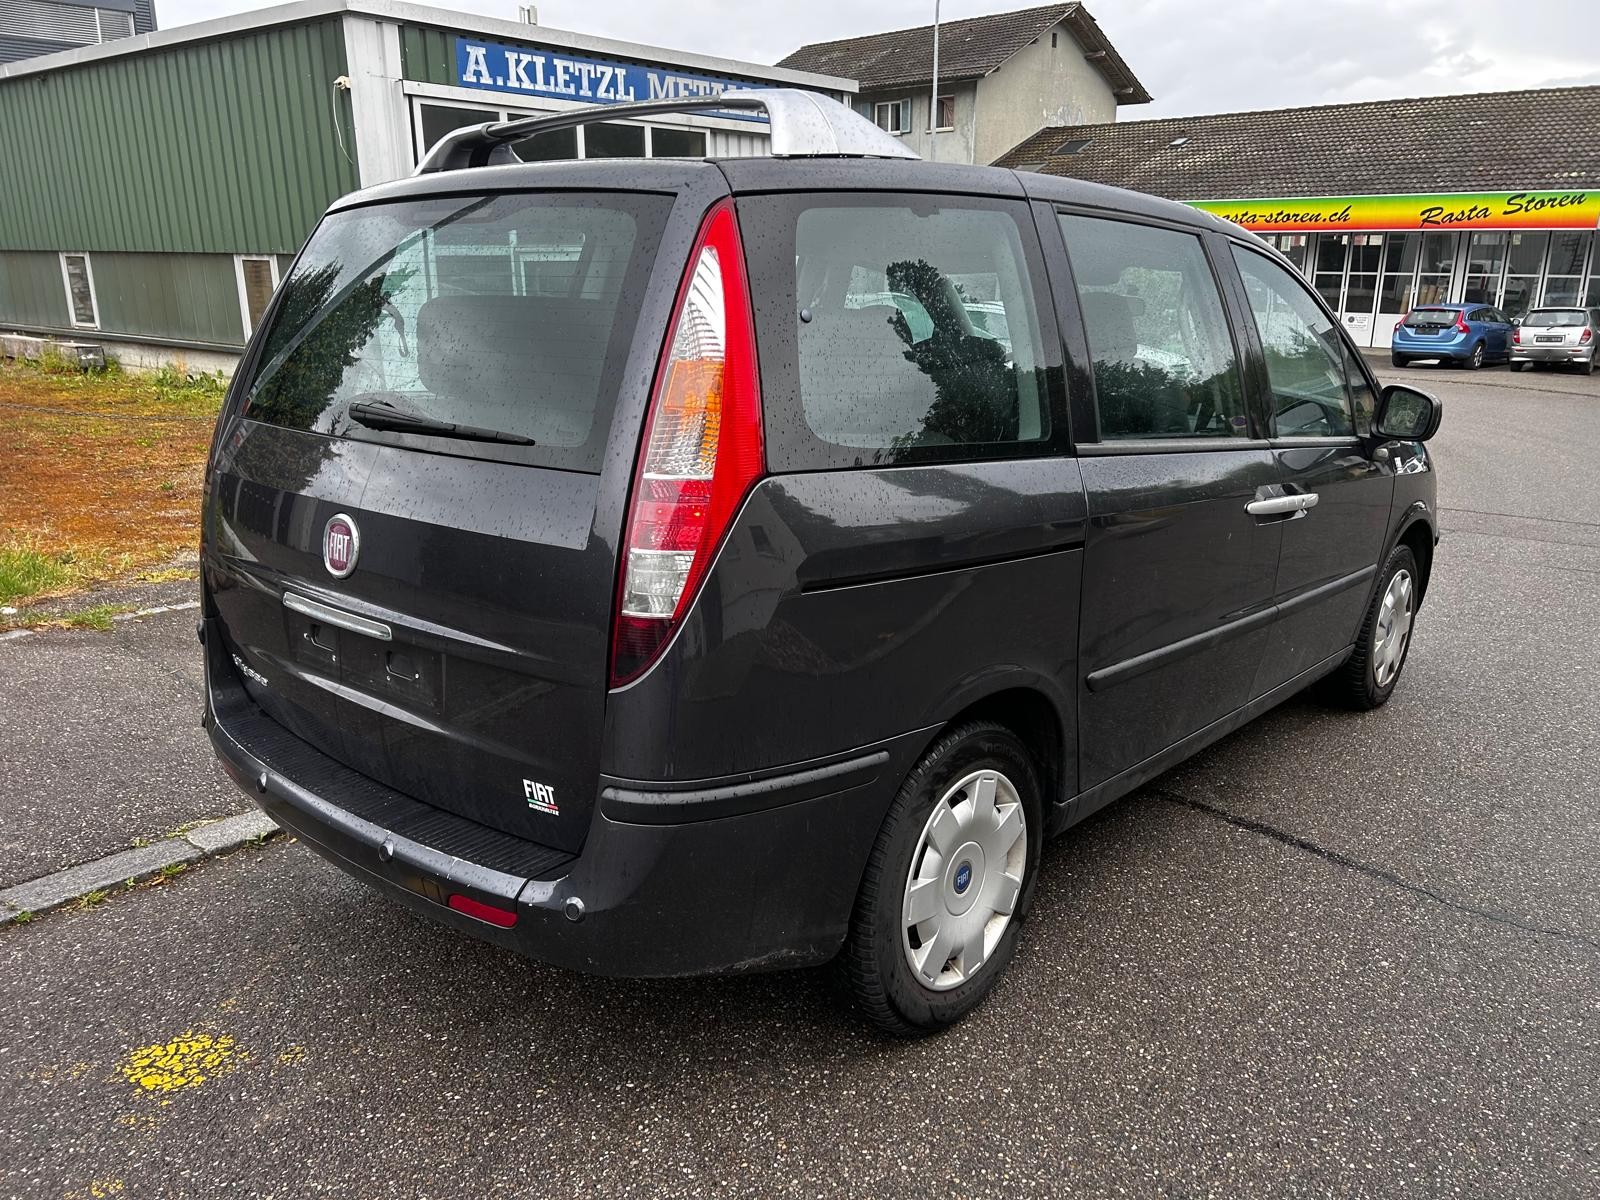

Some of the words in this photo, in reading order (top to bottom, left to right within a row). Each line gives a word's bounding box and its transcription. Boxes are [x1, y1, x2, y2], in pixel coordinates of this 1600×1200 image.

[1218, 205, 1352, 224] asta-storen.ch
[1420, 206, 1492, 228] Rasta
[1503, 193, 1587, 215] Storen
[330, 531, 350, 562] FIAT
[523, 779, 555, 805] FIAT
[957, 870, 970, 886] FIAT
